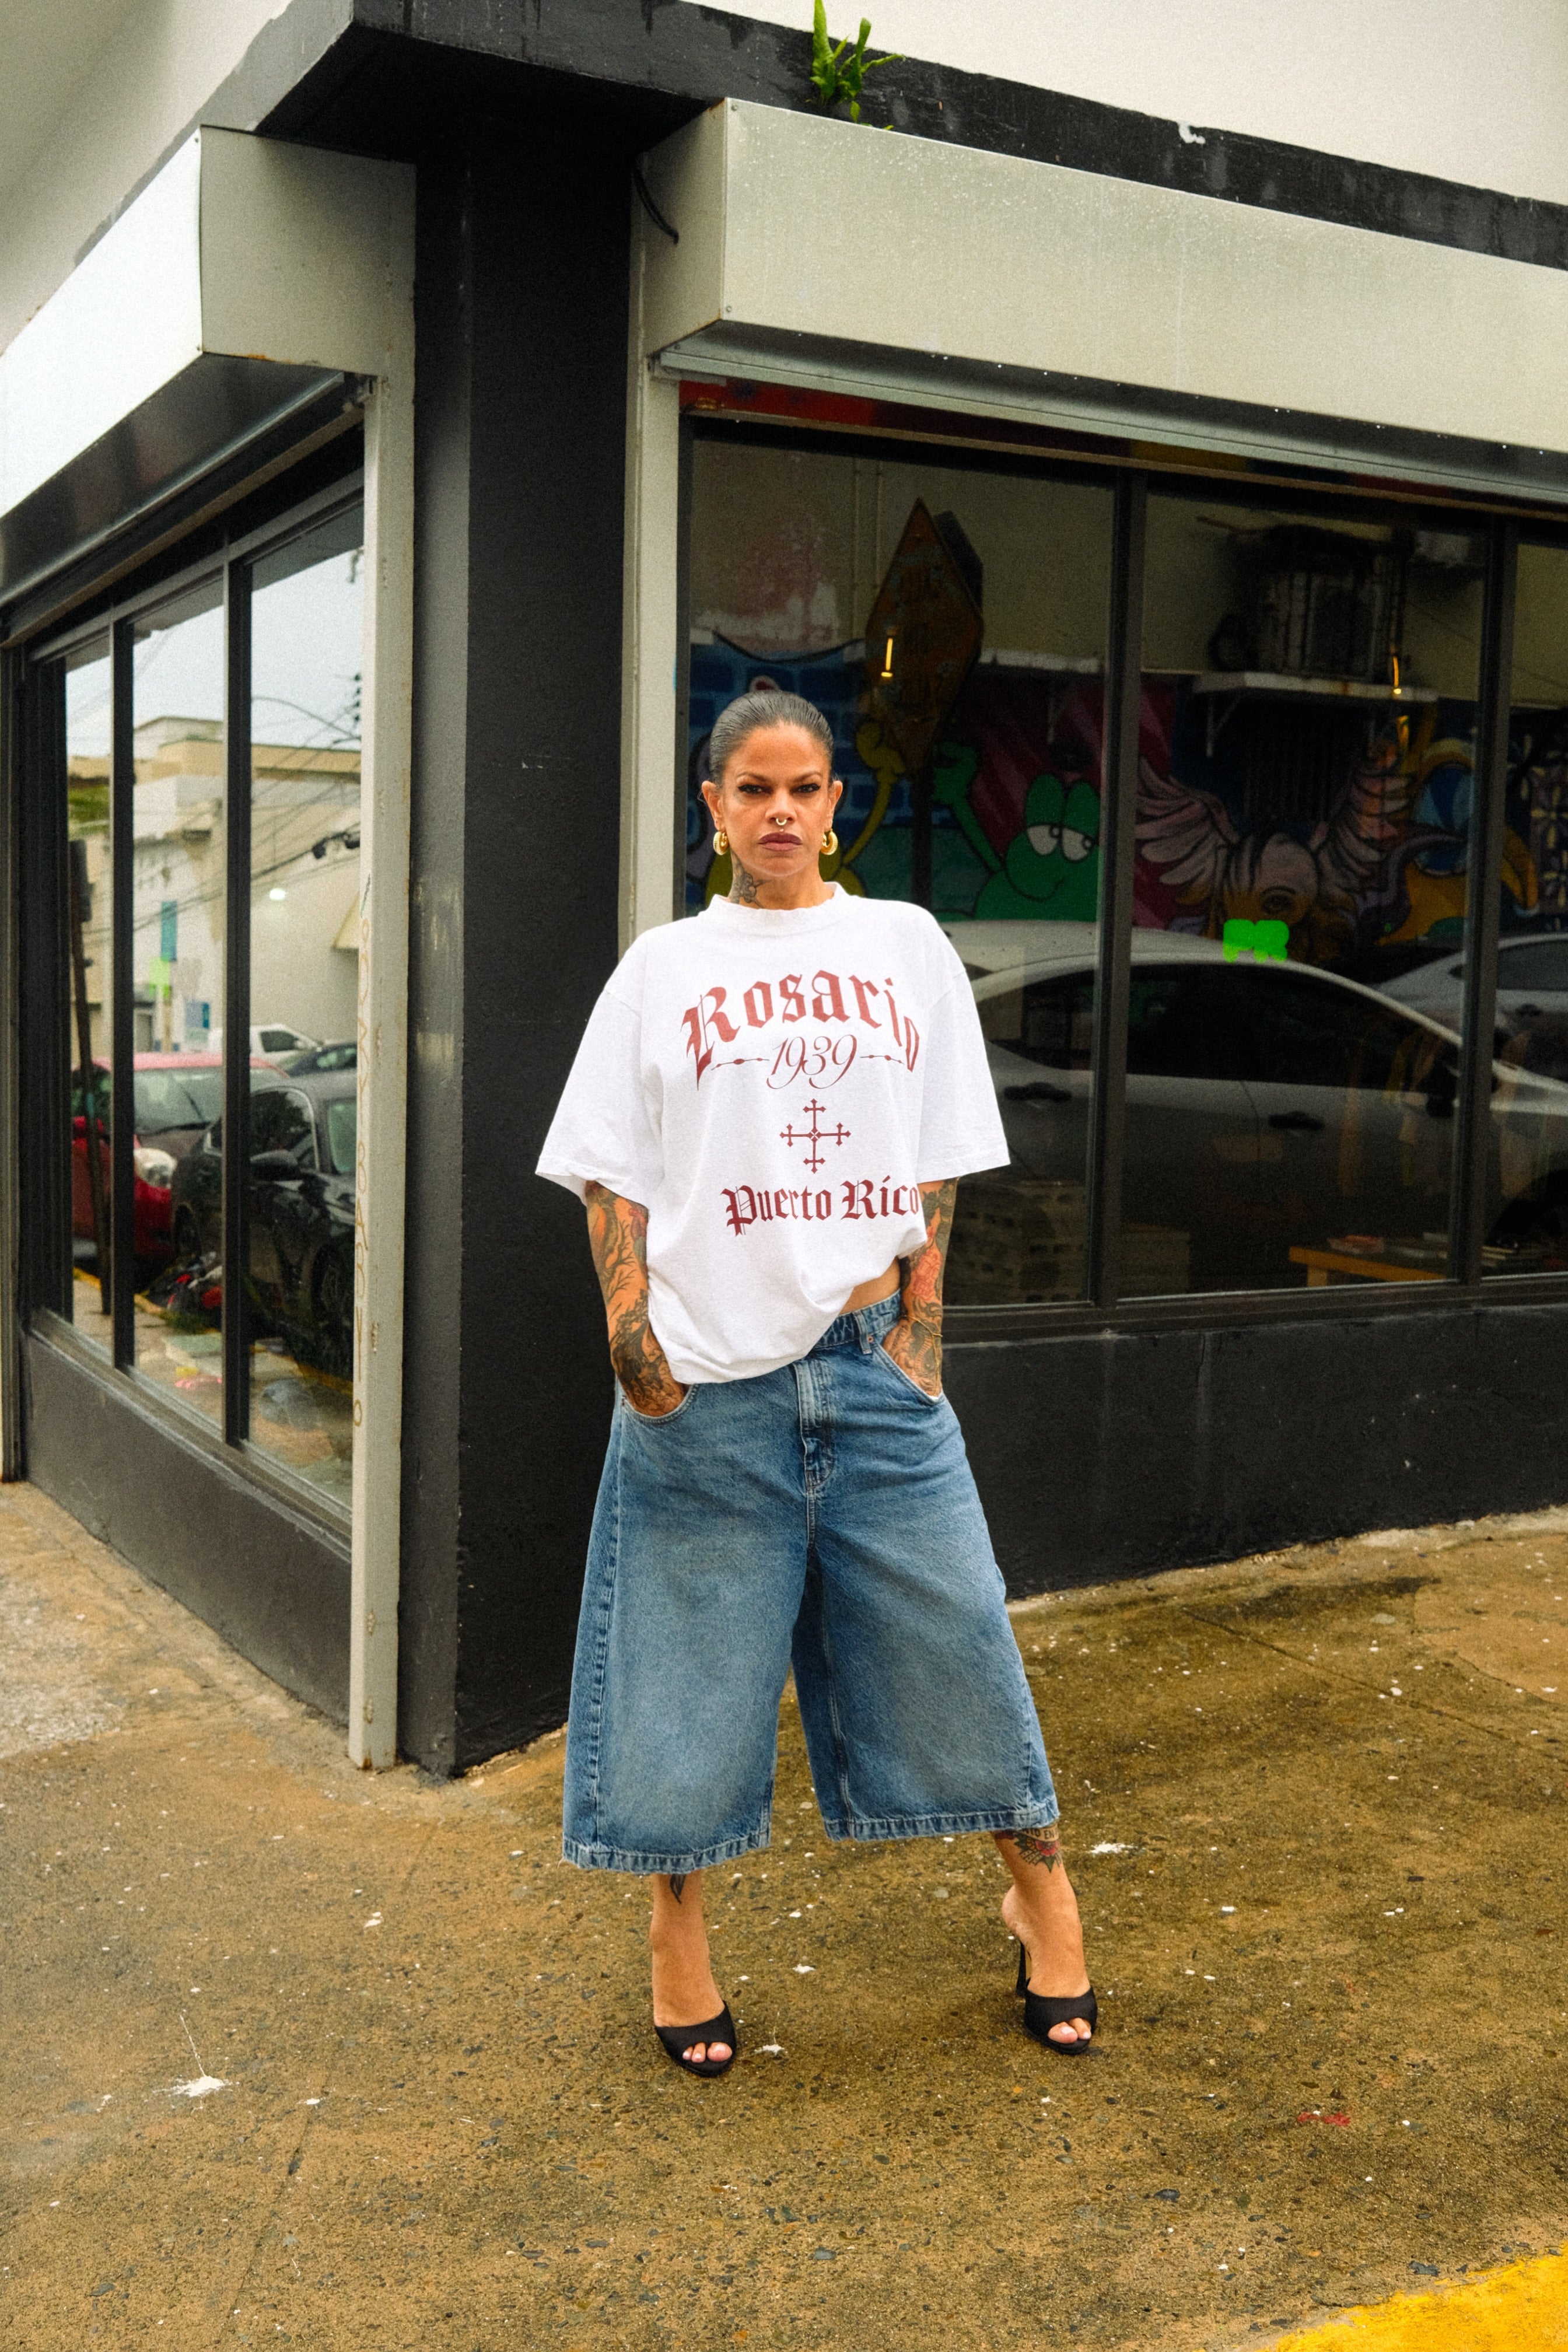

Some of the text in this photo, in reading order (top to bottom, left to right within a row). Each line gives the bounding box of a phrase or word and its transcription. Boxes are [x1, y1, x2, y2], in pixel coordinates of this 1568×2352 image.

[680, 970, 919, 1091] Rosario
[766, 1034, 858, 1090] 1939
[720, 1185, 832, 1237] Puerto
